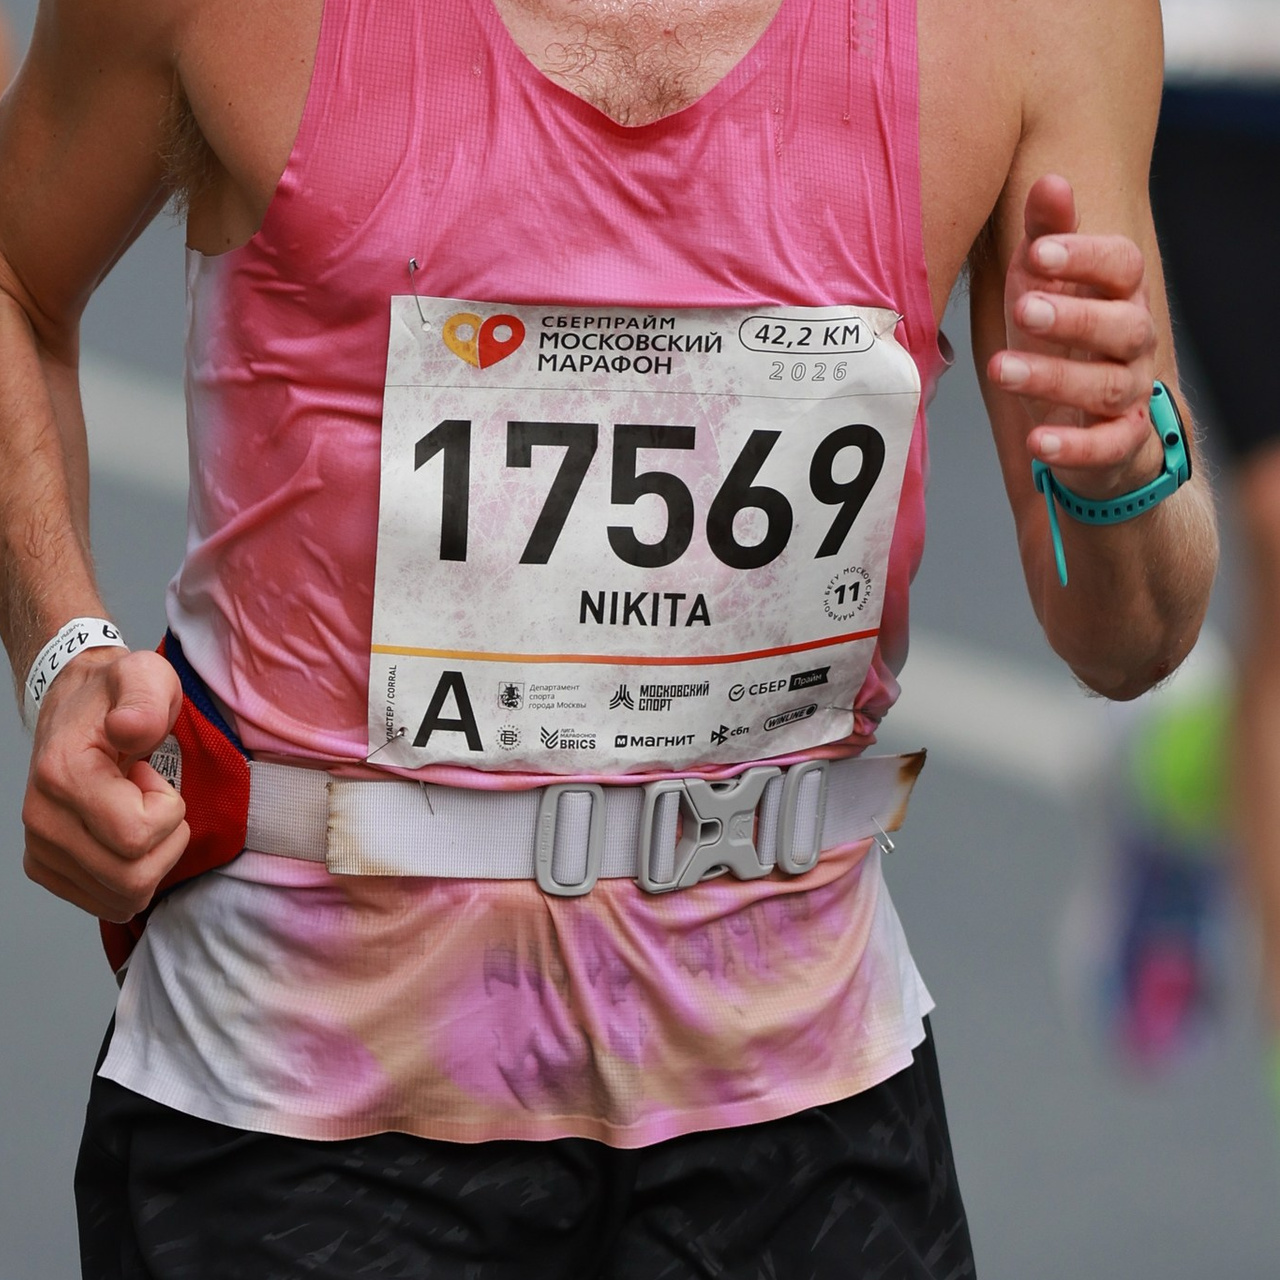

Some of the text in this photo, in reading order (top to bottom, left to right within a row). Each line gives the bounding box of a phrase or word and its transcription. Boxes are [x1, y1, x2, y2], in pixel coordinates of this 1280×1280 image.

[541, 314, 676, 330] СБЕРПРАЙМ
[539, 331, 723, 354] МОСКОВСКИЙ
[754, 324, 813, 349] 42,2
[537, 354, 673, 375] МАРАФОН
[769, 360, 848, 382] 2026
[413, 418, 886, 570] 17569
[823, 566, 872, 621] БЕГУ МОСКОВСКИЙ МАРАФОН
[834, 581, 860, 605] 11
[578, 589, 712, 627] NIKITA
[49, 631, 90, 670] 42,2
[387, 665, 396, 699] CORRAL
[529, 684, 580, 692] Департамент
[640, 680, 710, 698] МОСКОВСКИЙ
[749, 673, 823, 696] СБЕР Прайм
[528, 701, 587, 710] города Москвы
[638, 698, 673, 711] СПОРТ
[767, 708, 806, 728] WINLINE
[630, 734, 696, 747] магнит
[730, 726, 750, 737] сбп
[560, 739, 596, 749] BRICS
